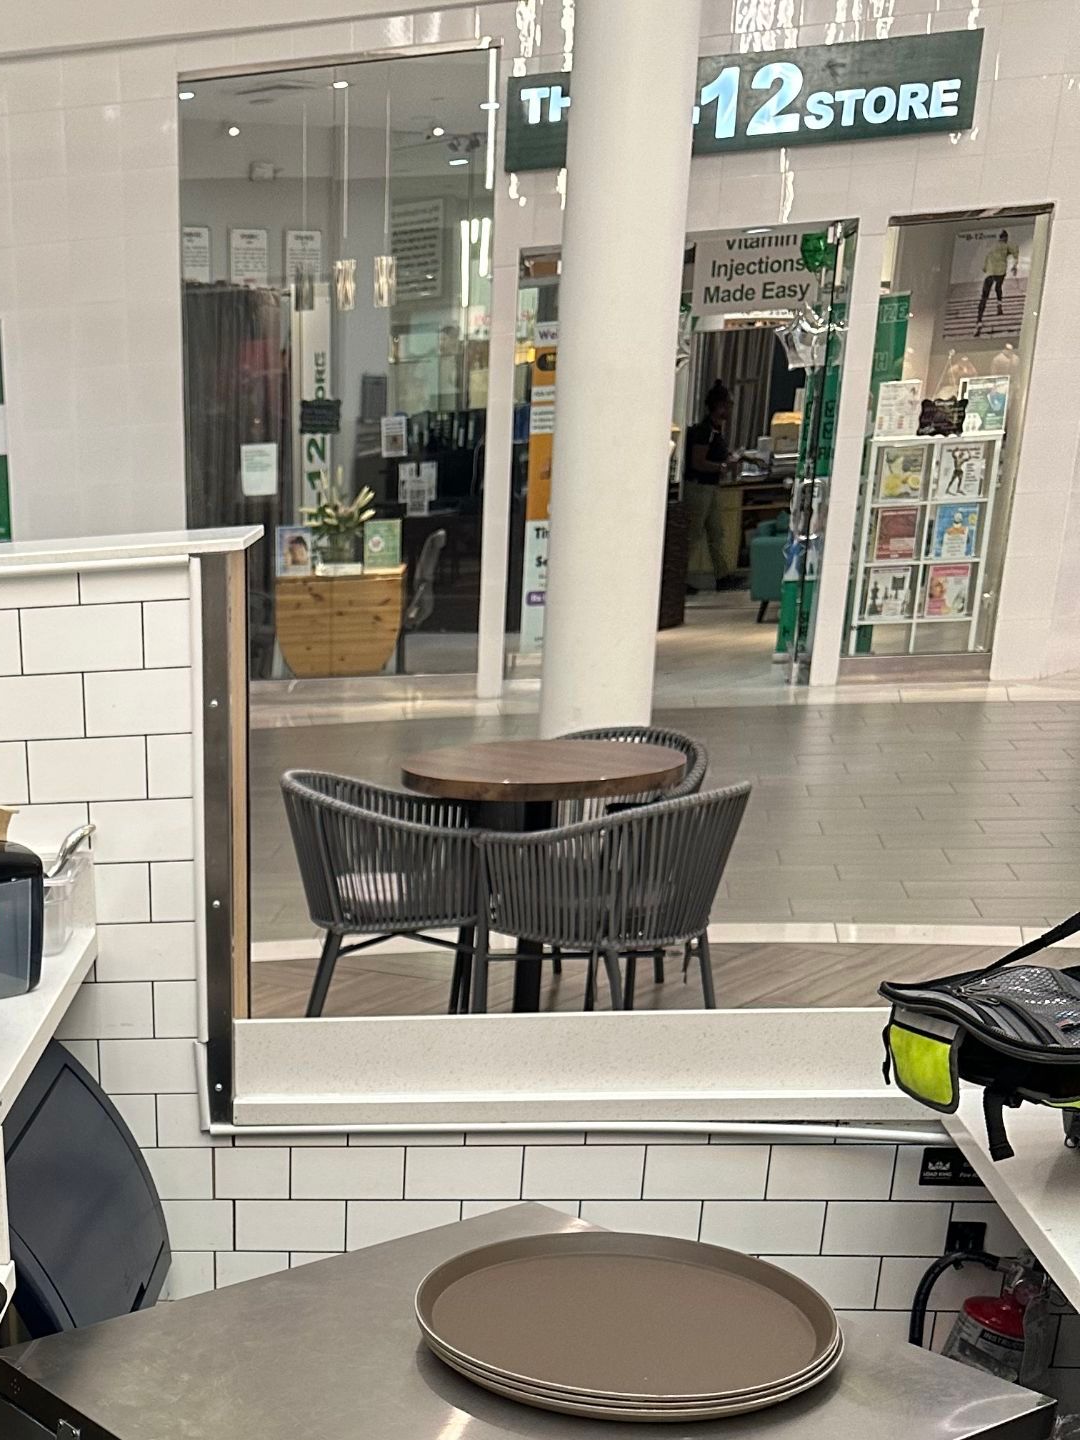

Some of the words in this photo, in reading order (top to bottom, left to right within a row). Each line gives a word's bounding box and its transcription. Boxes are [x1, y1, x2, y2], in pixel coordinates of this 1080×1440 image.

[520, 86, 571, 124] TH
[692, 61, 804, 139] -12
[804, 78, 962, 131] STORE
[726, 234, 798, 251] Vitamin
[711, 256, 808, 281] Injections
[703, 284, 756, 304] Made
[762, 281, 811, 302] Easy
